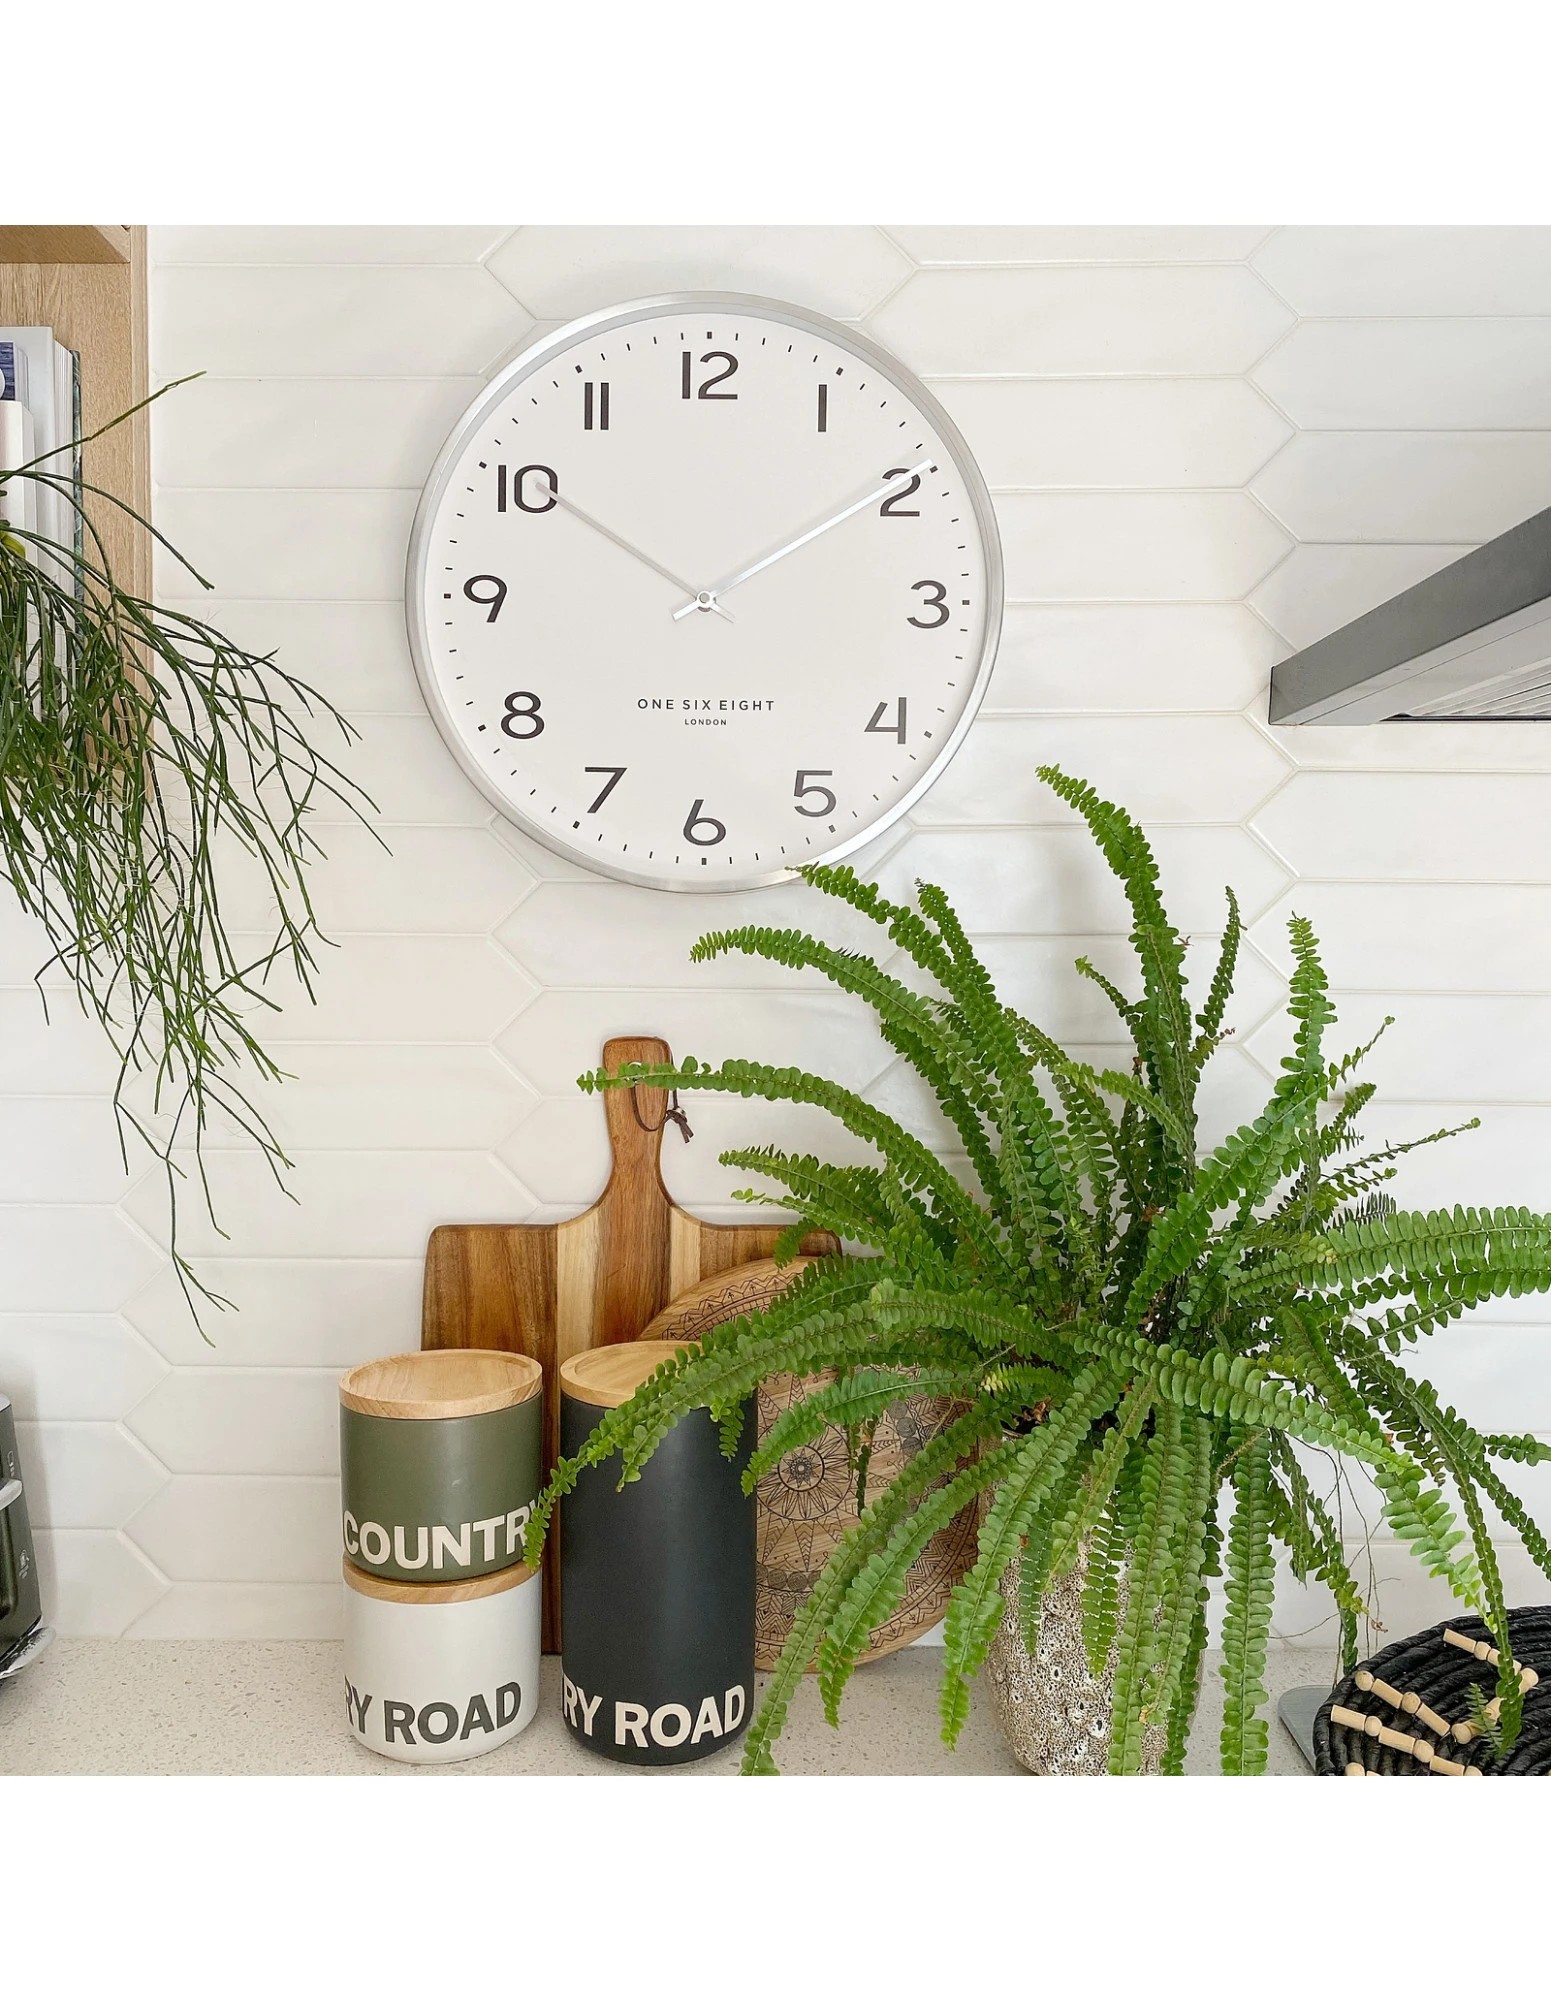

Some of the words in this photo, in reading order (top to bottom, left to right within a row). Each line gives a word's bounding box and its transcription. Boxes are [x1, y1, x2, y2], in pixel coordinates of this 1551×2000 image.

[682, 351, 738, 400] 12
[584, 382, 609, 430] 11
[818, 384, 827, 432] 1
[498, 465, 558, 513] 10
[880, 467, 921, 517] 2
[463, 575, 507, 623] 9
[907, 580, 949, 629] 3
[501, 691, 545, 739] 8
[638, 699, 674, 709] ONE
[682, 700, 711, 710] SIX
[719, 700, 774, 710] EIGHT
[864, 697, 906, 744] 4
[585, 767, 627, 813] 7
[793, 770, 836, 817] 5
[683, 799, 726, 846] 6
[384, 1682, 521, 1745] ROAD
[615, 1684, 746, 1748] ROAD
